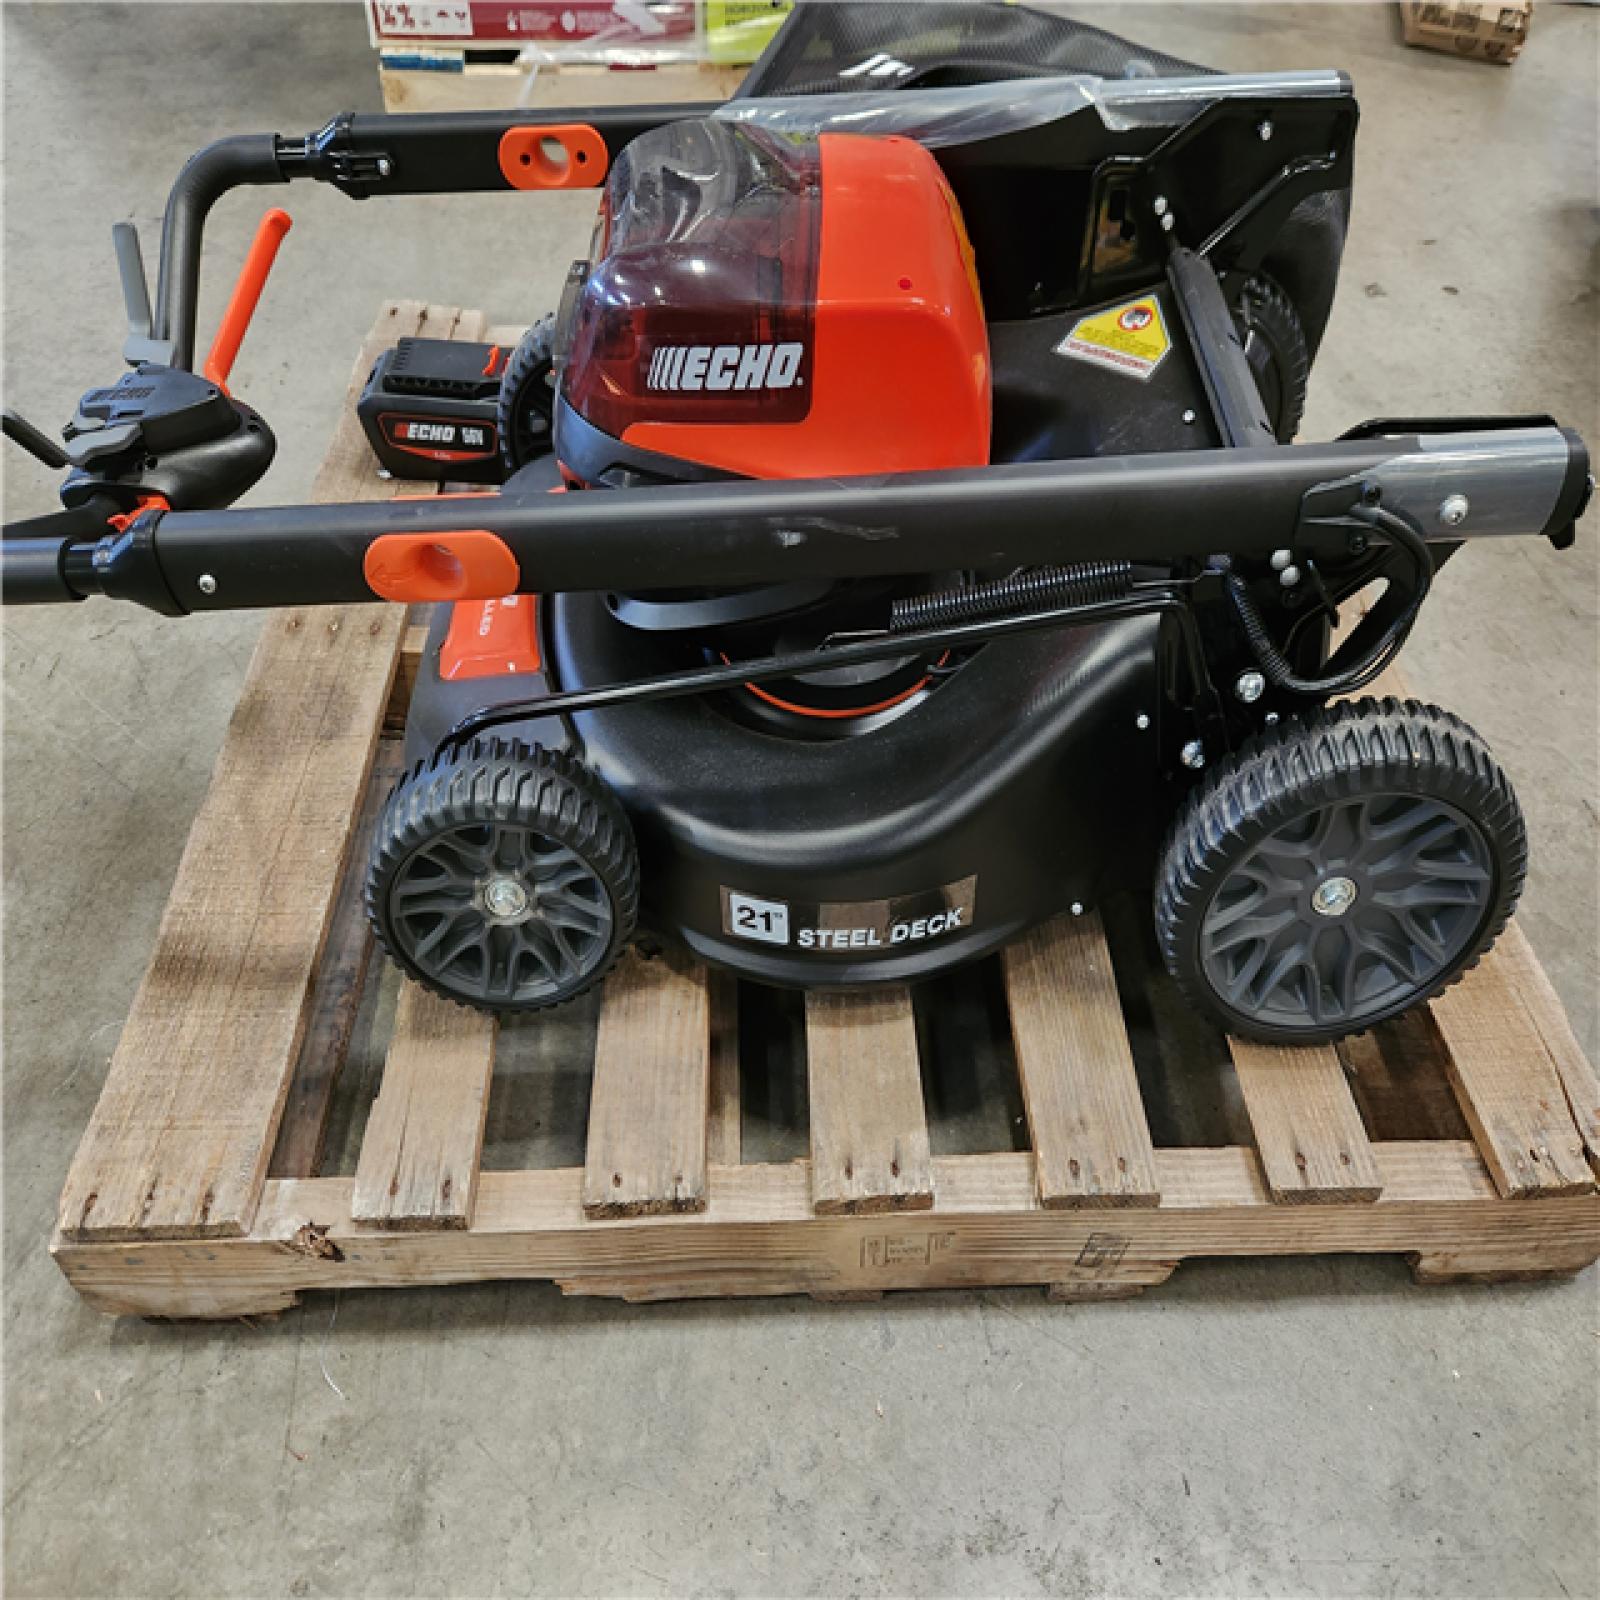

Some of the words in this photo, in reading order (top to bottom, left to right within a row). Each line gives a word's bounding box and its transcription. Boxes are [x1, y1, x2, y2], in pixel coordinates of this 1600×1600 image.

[681, 342, 803, 391] ECHO
[407, 422, 456, 443] ECHO
[798, 928, 881, 948] STEEL
[891, 909, 962, 944] DECK
